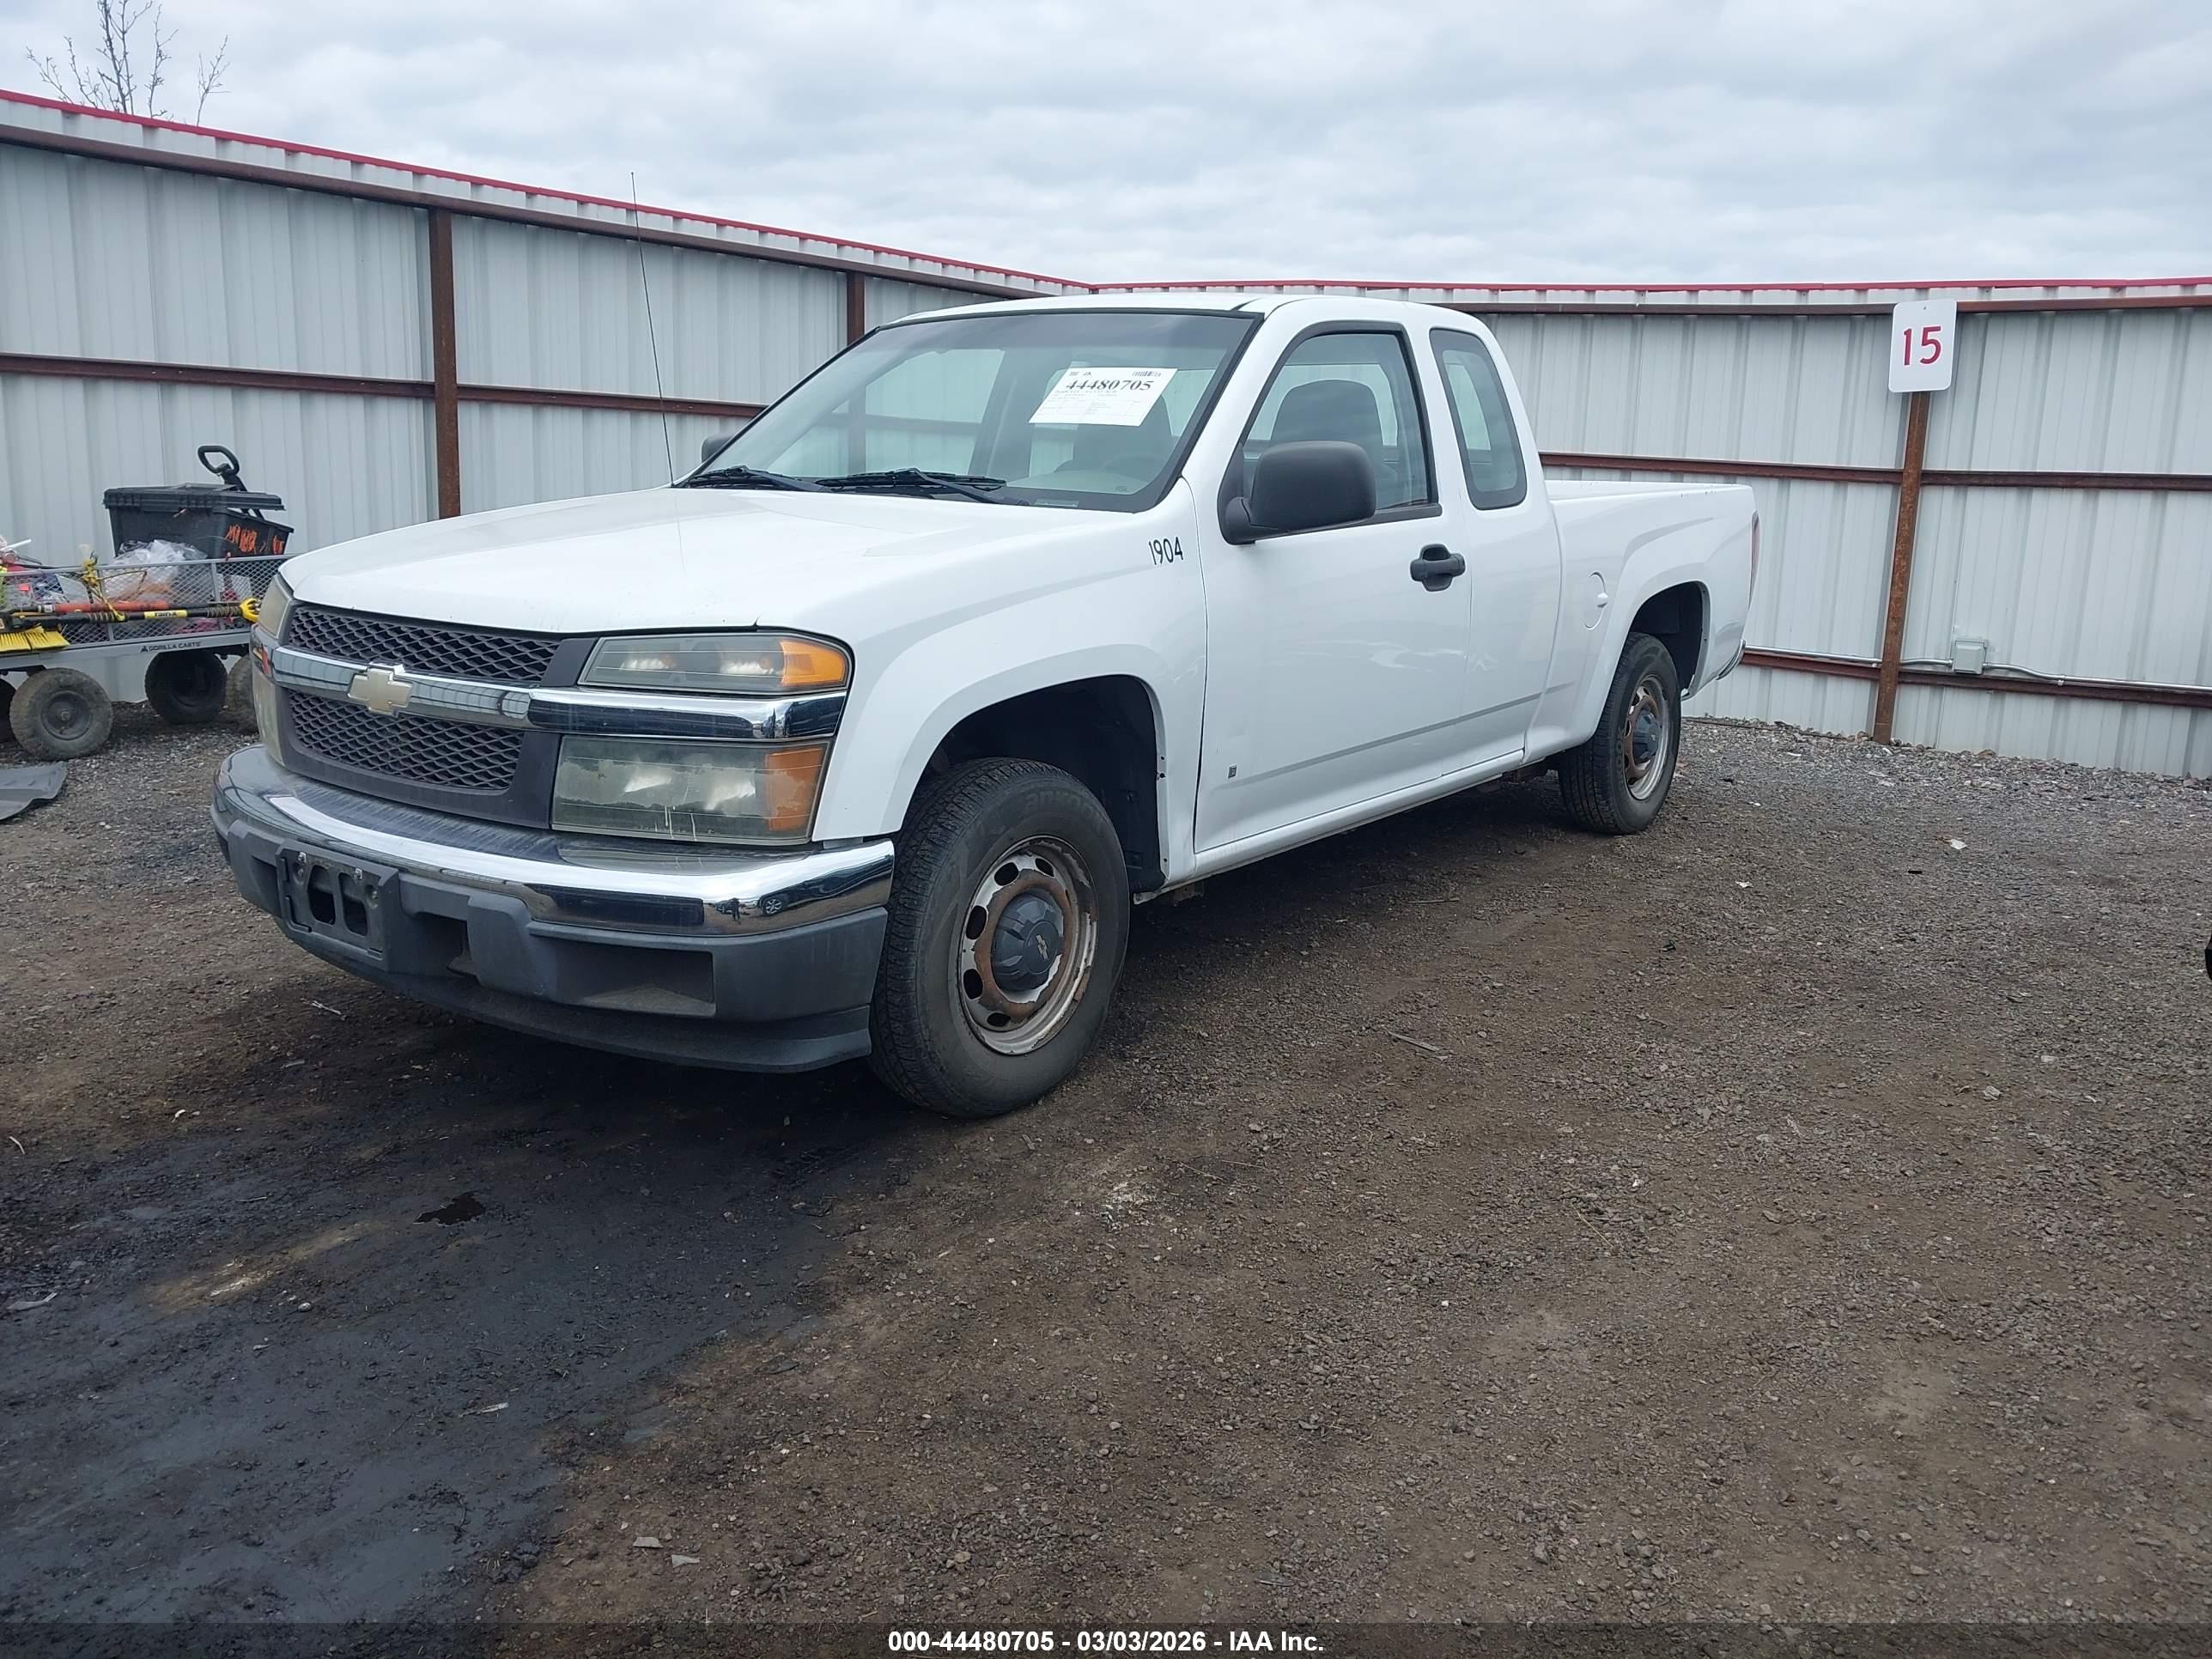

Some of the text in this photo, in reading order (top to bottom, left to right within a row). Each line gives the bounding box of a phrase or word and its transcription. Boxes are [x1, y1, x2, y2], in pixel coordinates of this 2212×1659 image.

[1903, 325, 1942, 366] 15
[1065, 379, 1155, 392] 44480705
[1148, 536, 1184, 566] 1904
